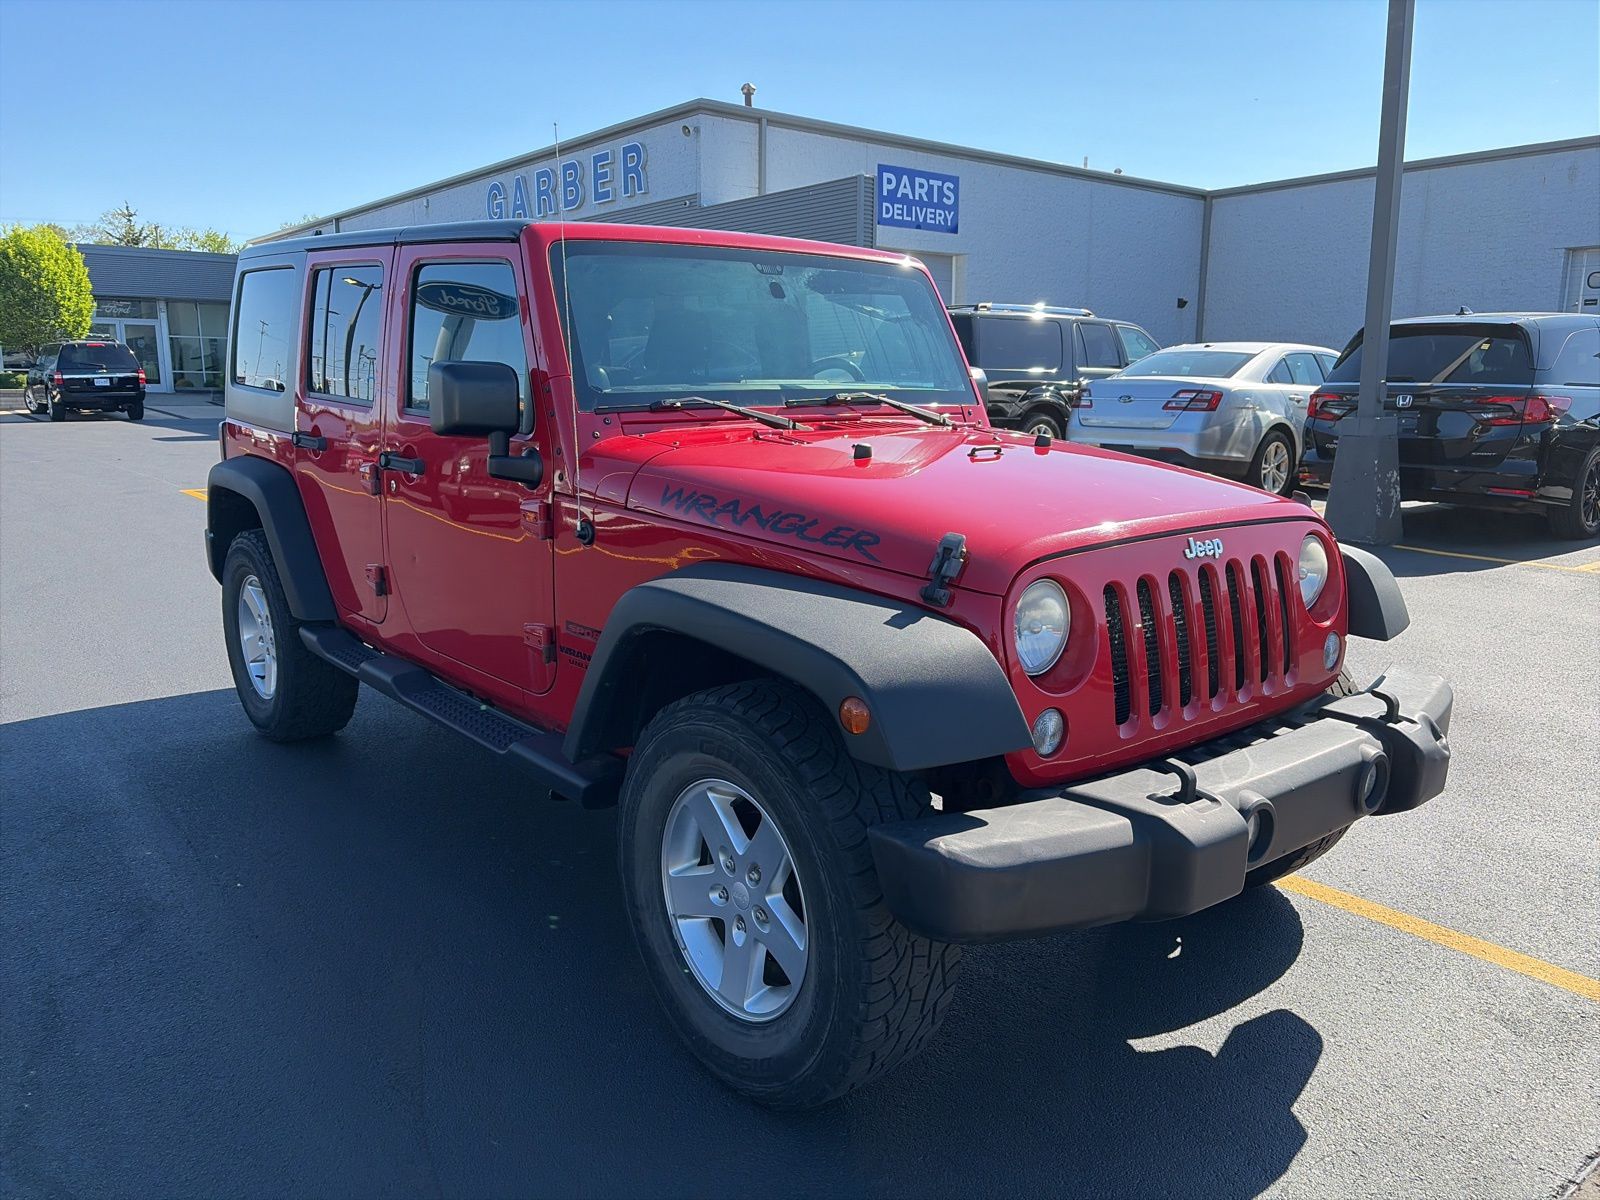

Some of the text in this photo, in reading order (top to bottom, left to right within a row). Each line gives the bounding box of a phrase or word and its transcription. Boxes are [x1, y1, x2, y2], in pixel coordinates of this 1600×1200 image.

[486, 142, 649, 221] GARBER
[882, 171, 955, 206] PARTS
[882, 202, 955, 227] DELIVERY
[660, 483, 882, 563] WRANGLER
[1184, 537, 1224, 560] Jeep
[567, 624, 601, 641] SPOR
[560, 645, 592, 662] WRAN
